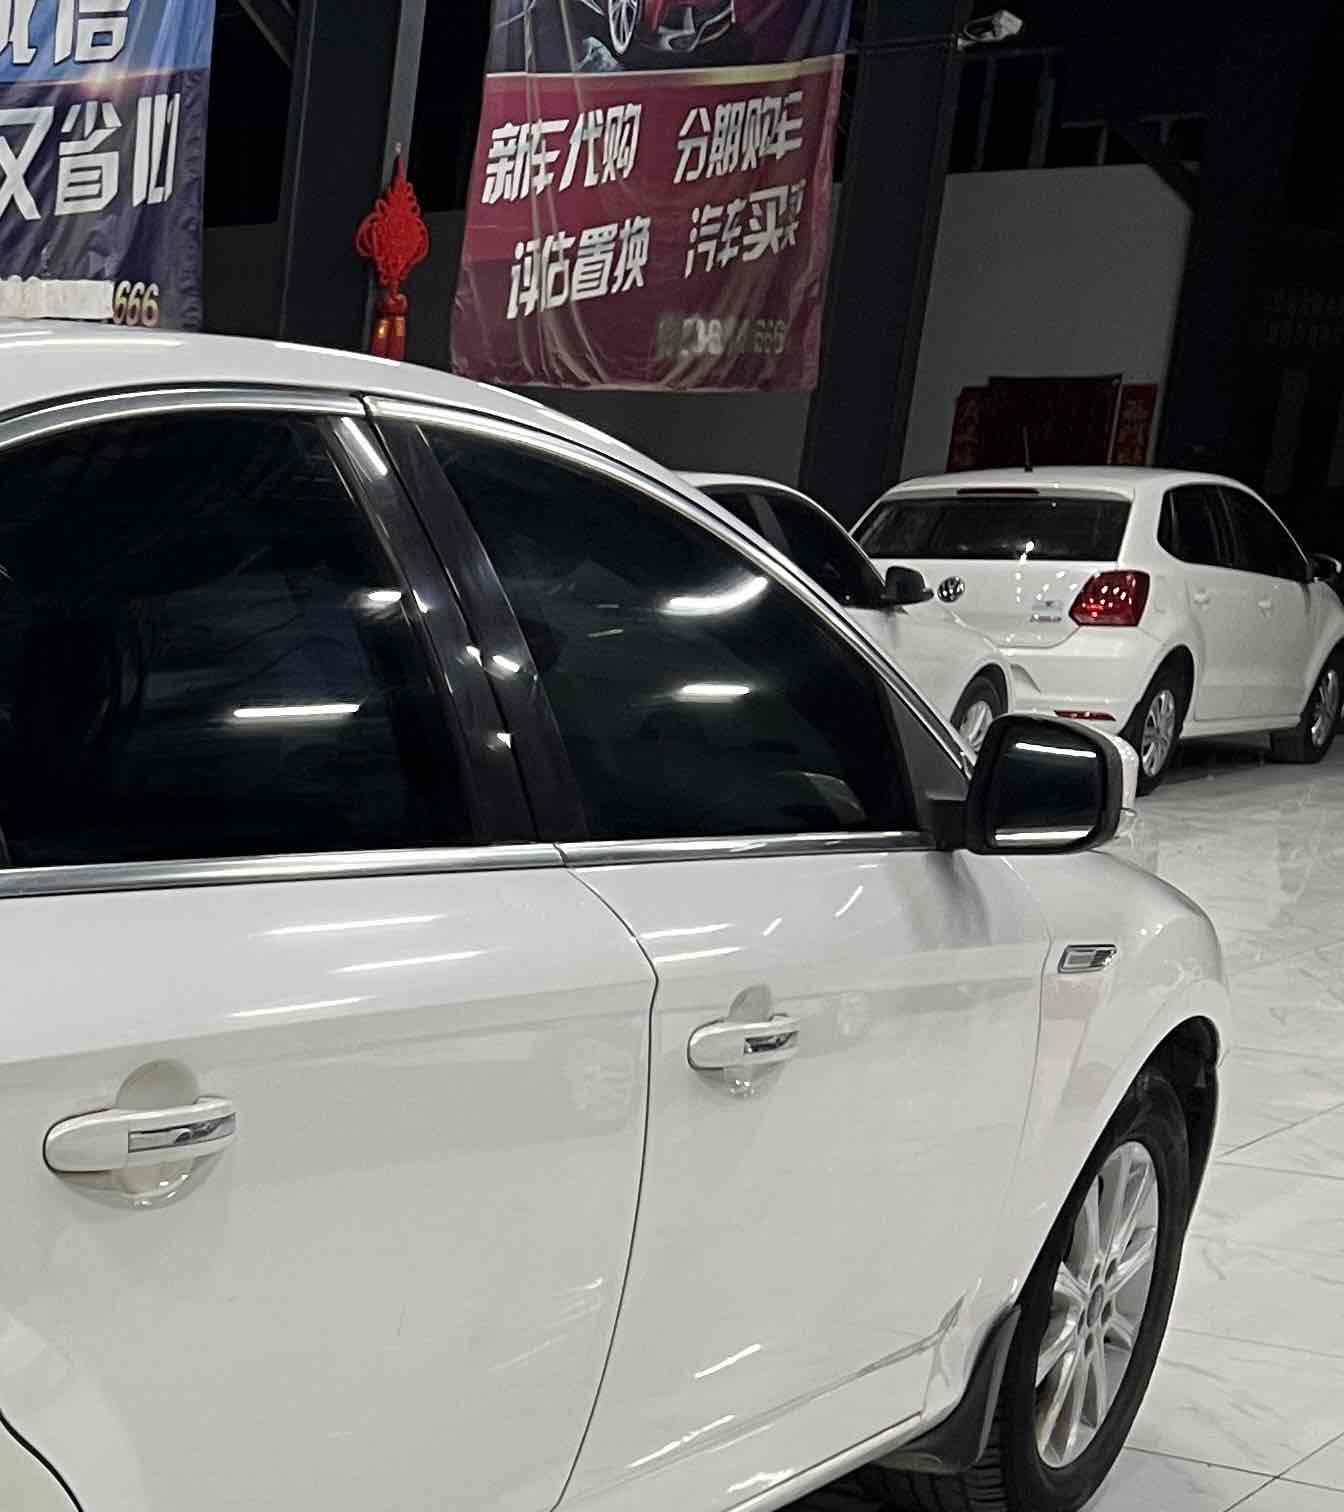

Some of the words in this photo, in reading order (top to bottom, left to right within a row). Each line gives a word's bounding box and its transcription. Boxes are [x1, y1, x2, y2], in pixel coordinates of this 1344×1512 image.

[481, 103, 642, 204] 新车代购
[506, 216, 651, 320] 评估置换
